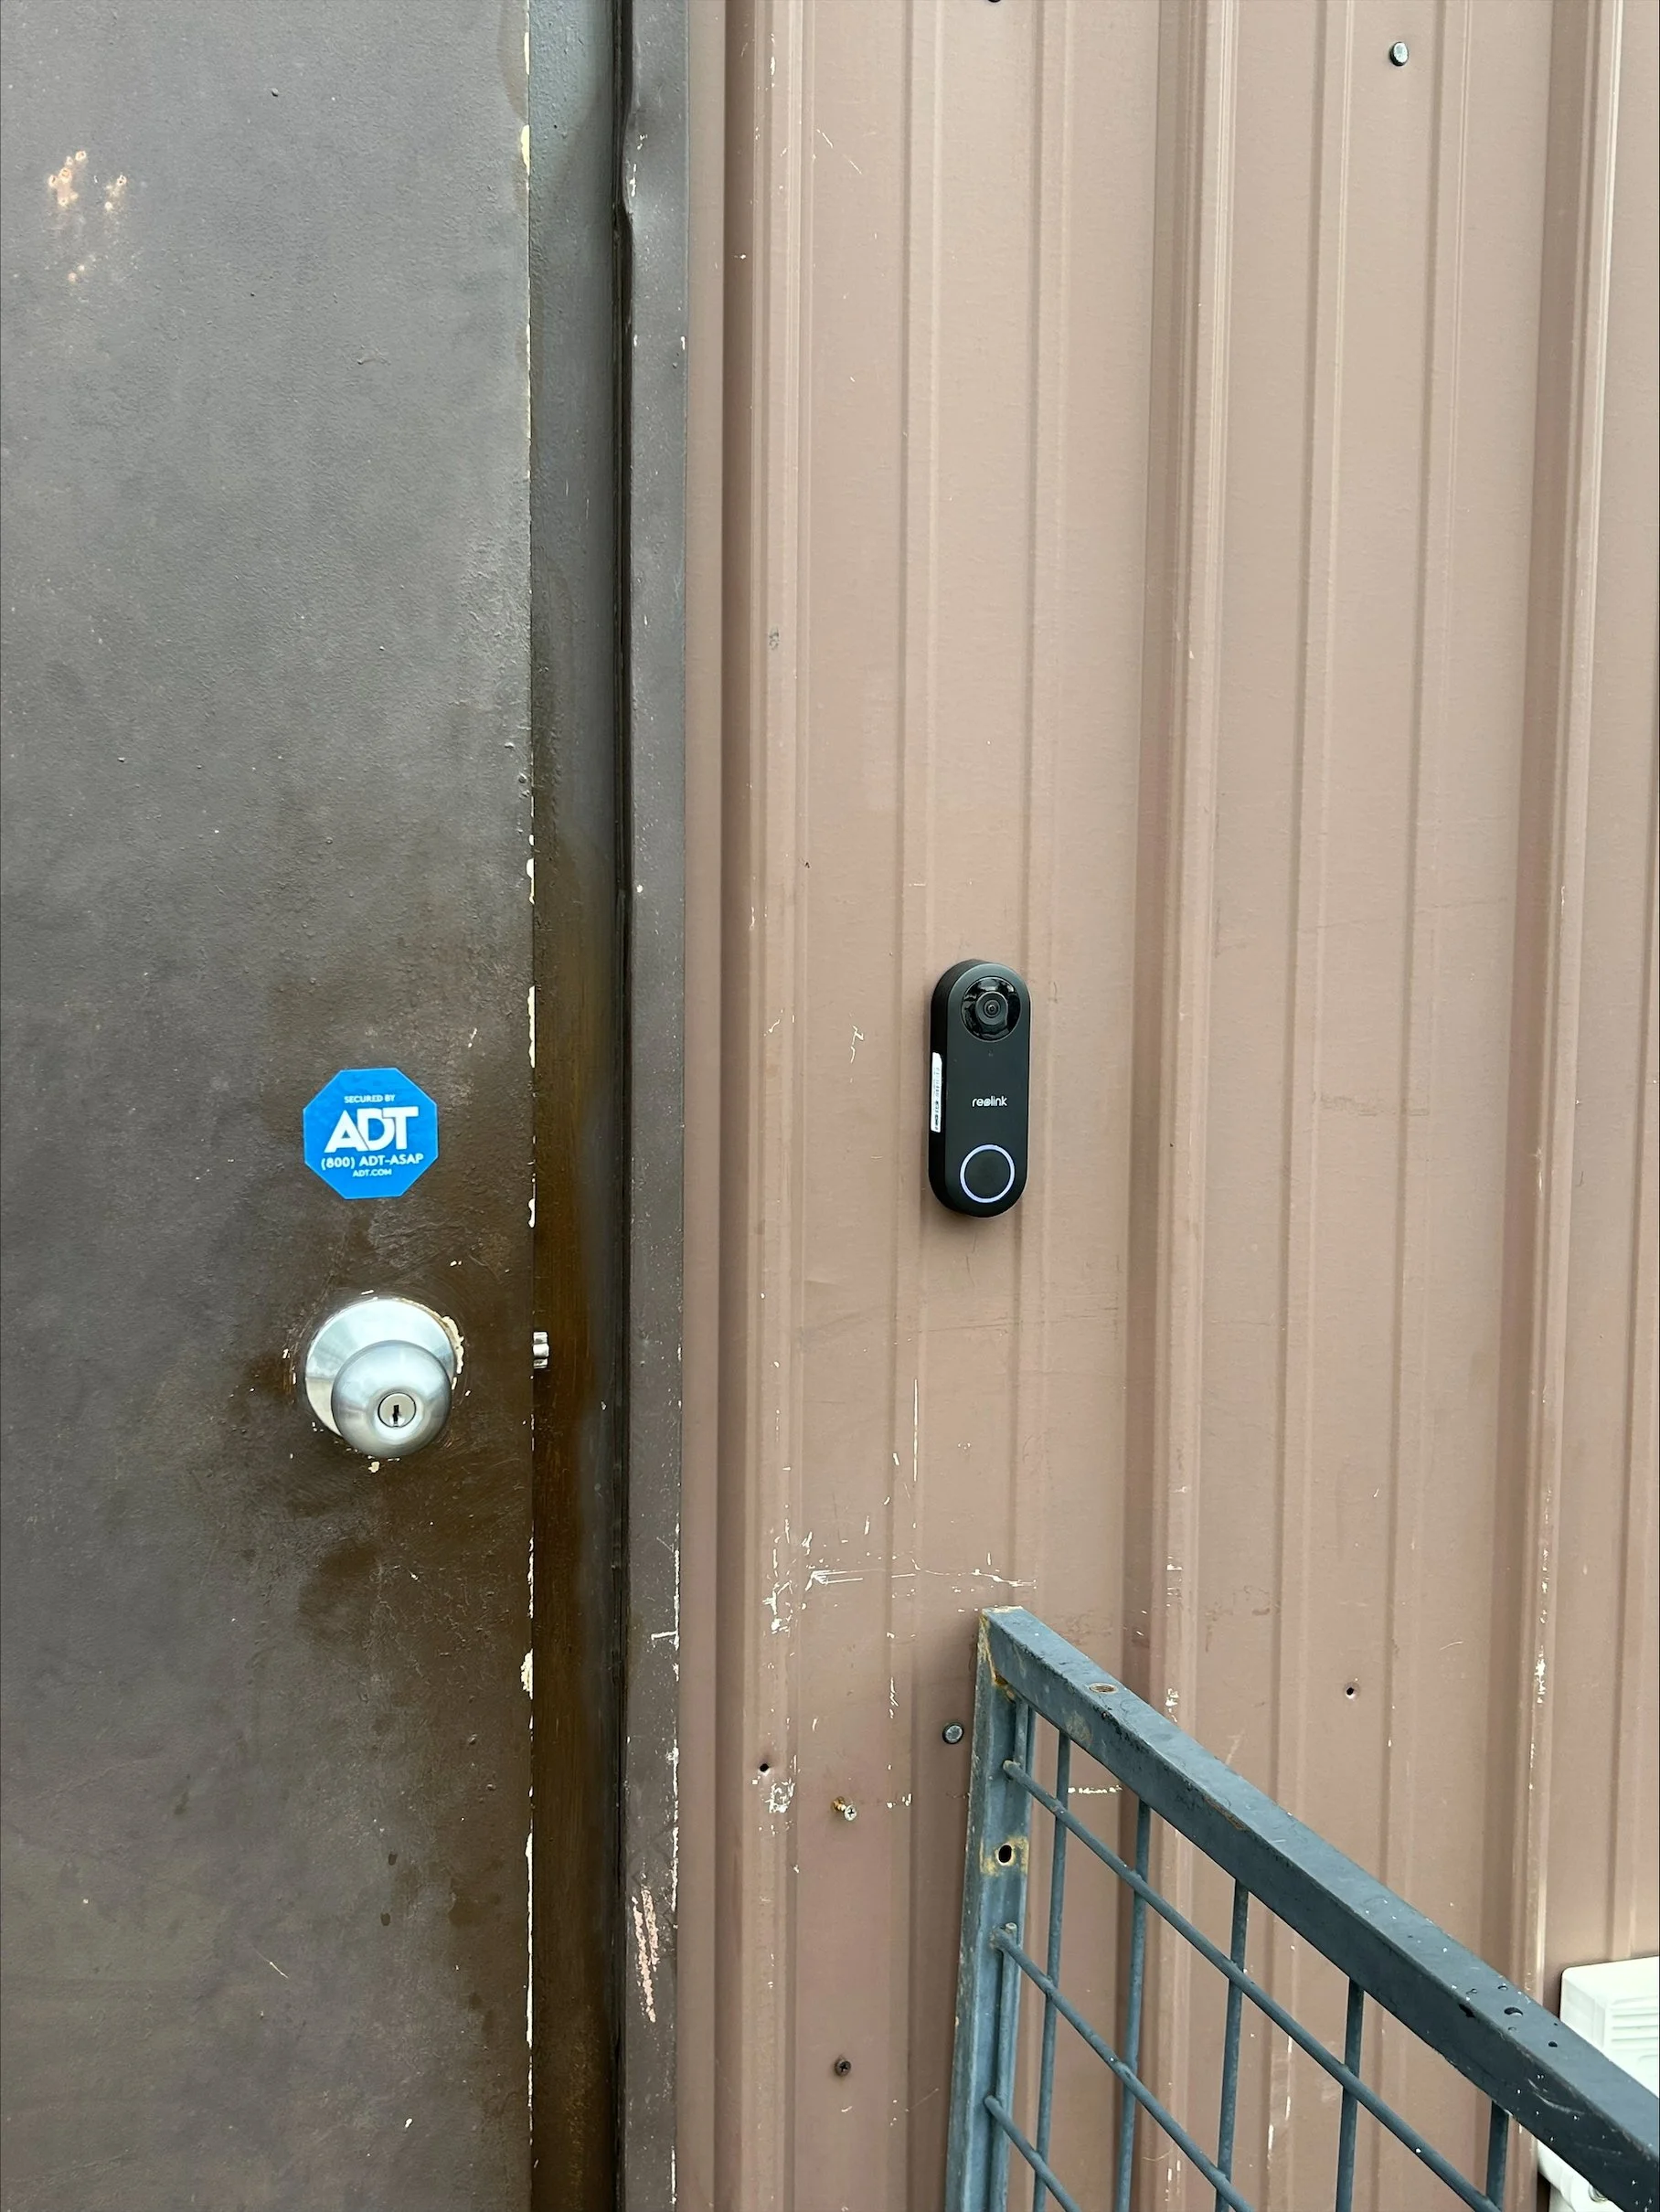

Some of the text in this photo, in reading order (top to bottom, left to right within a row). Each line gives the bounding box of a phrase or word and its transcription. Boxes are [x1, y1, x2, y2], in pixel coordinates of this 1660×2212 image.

[345, 1094, 395, 1103] SECURED BY
[972, 1096, 1007, 1107] reolink
[324, 1106, 419, 1154] ADT
[321, 1154, 424, 1170] (800) ADT-ASAP
[353, 1169, 392, 1177] ADT.COM
